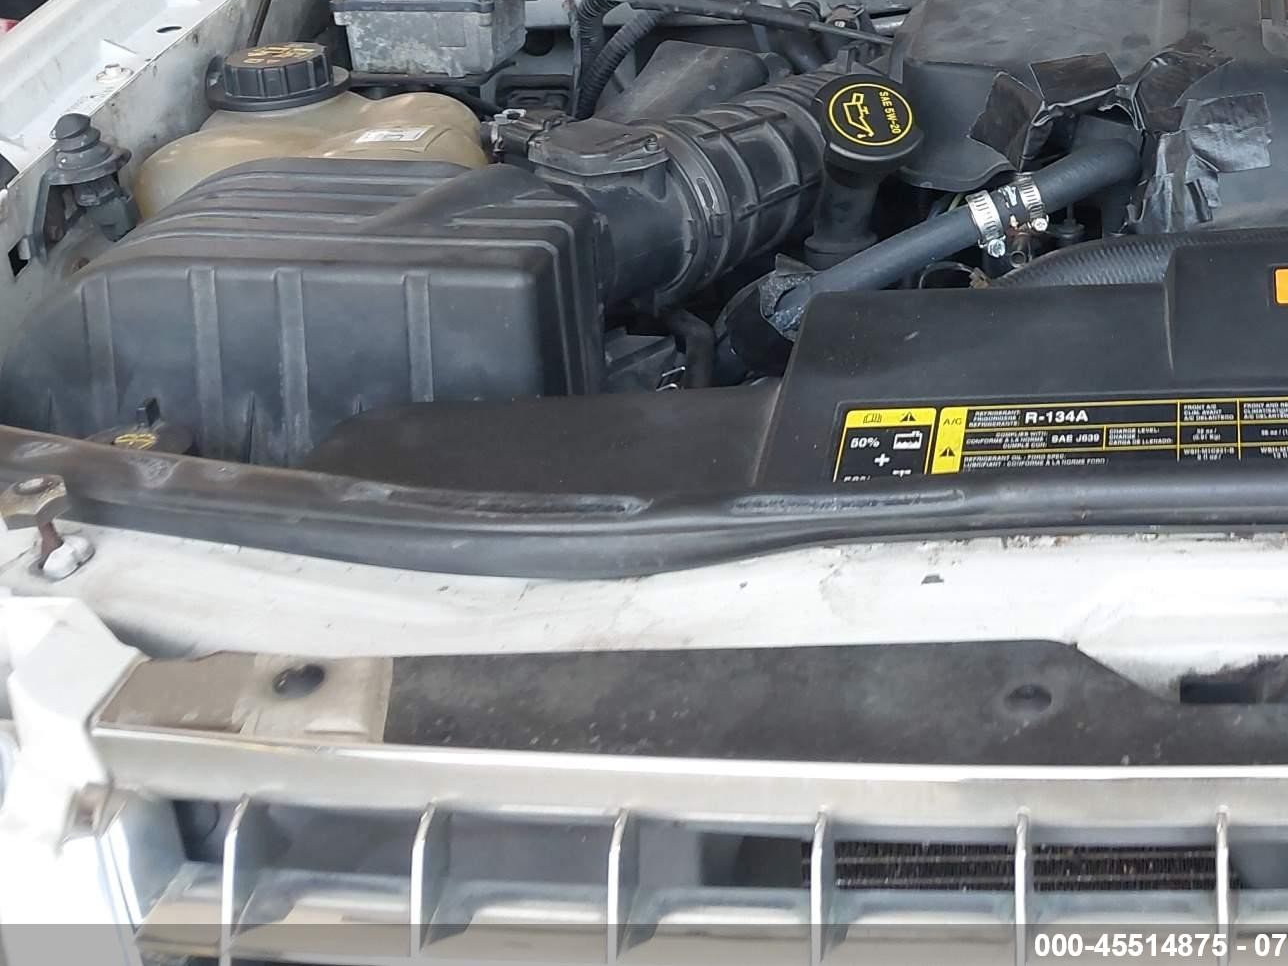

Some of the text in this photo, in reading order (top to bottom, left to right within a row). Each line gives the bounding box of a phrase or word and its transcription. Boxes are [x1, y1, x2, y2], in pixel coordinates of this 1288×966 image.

[879, 91, 902, 134] SAE 5W-20
[943, 418, 963, 426] A/C
[1024, 410, 1089, 424] R-134A
[850, 437, 880, 448] 50%
[1051, 434, 1073, 444] SAE
